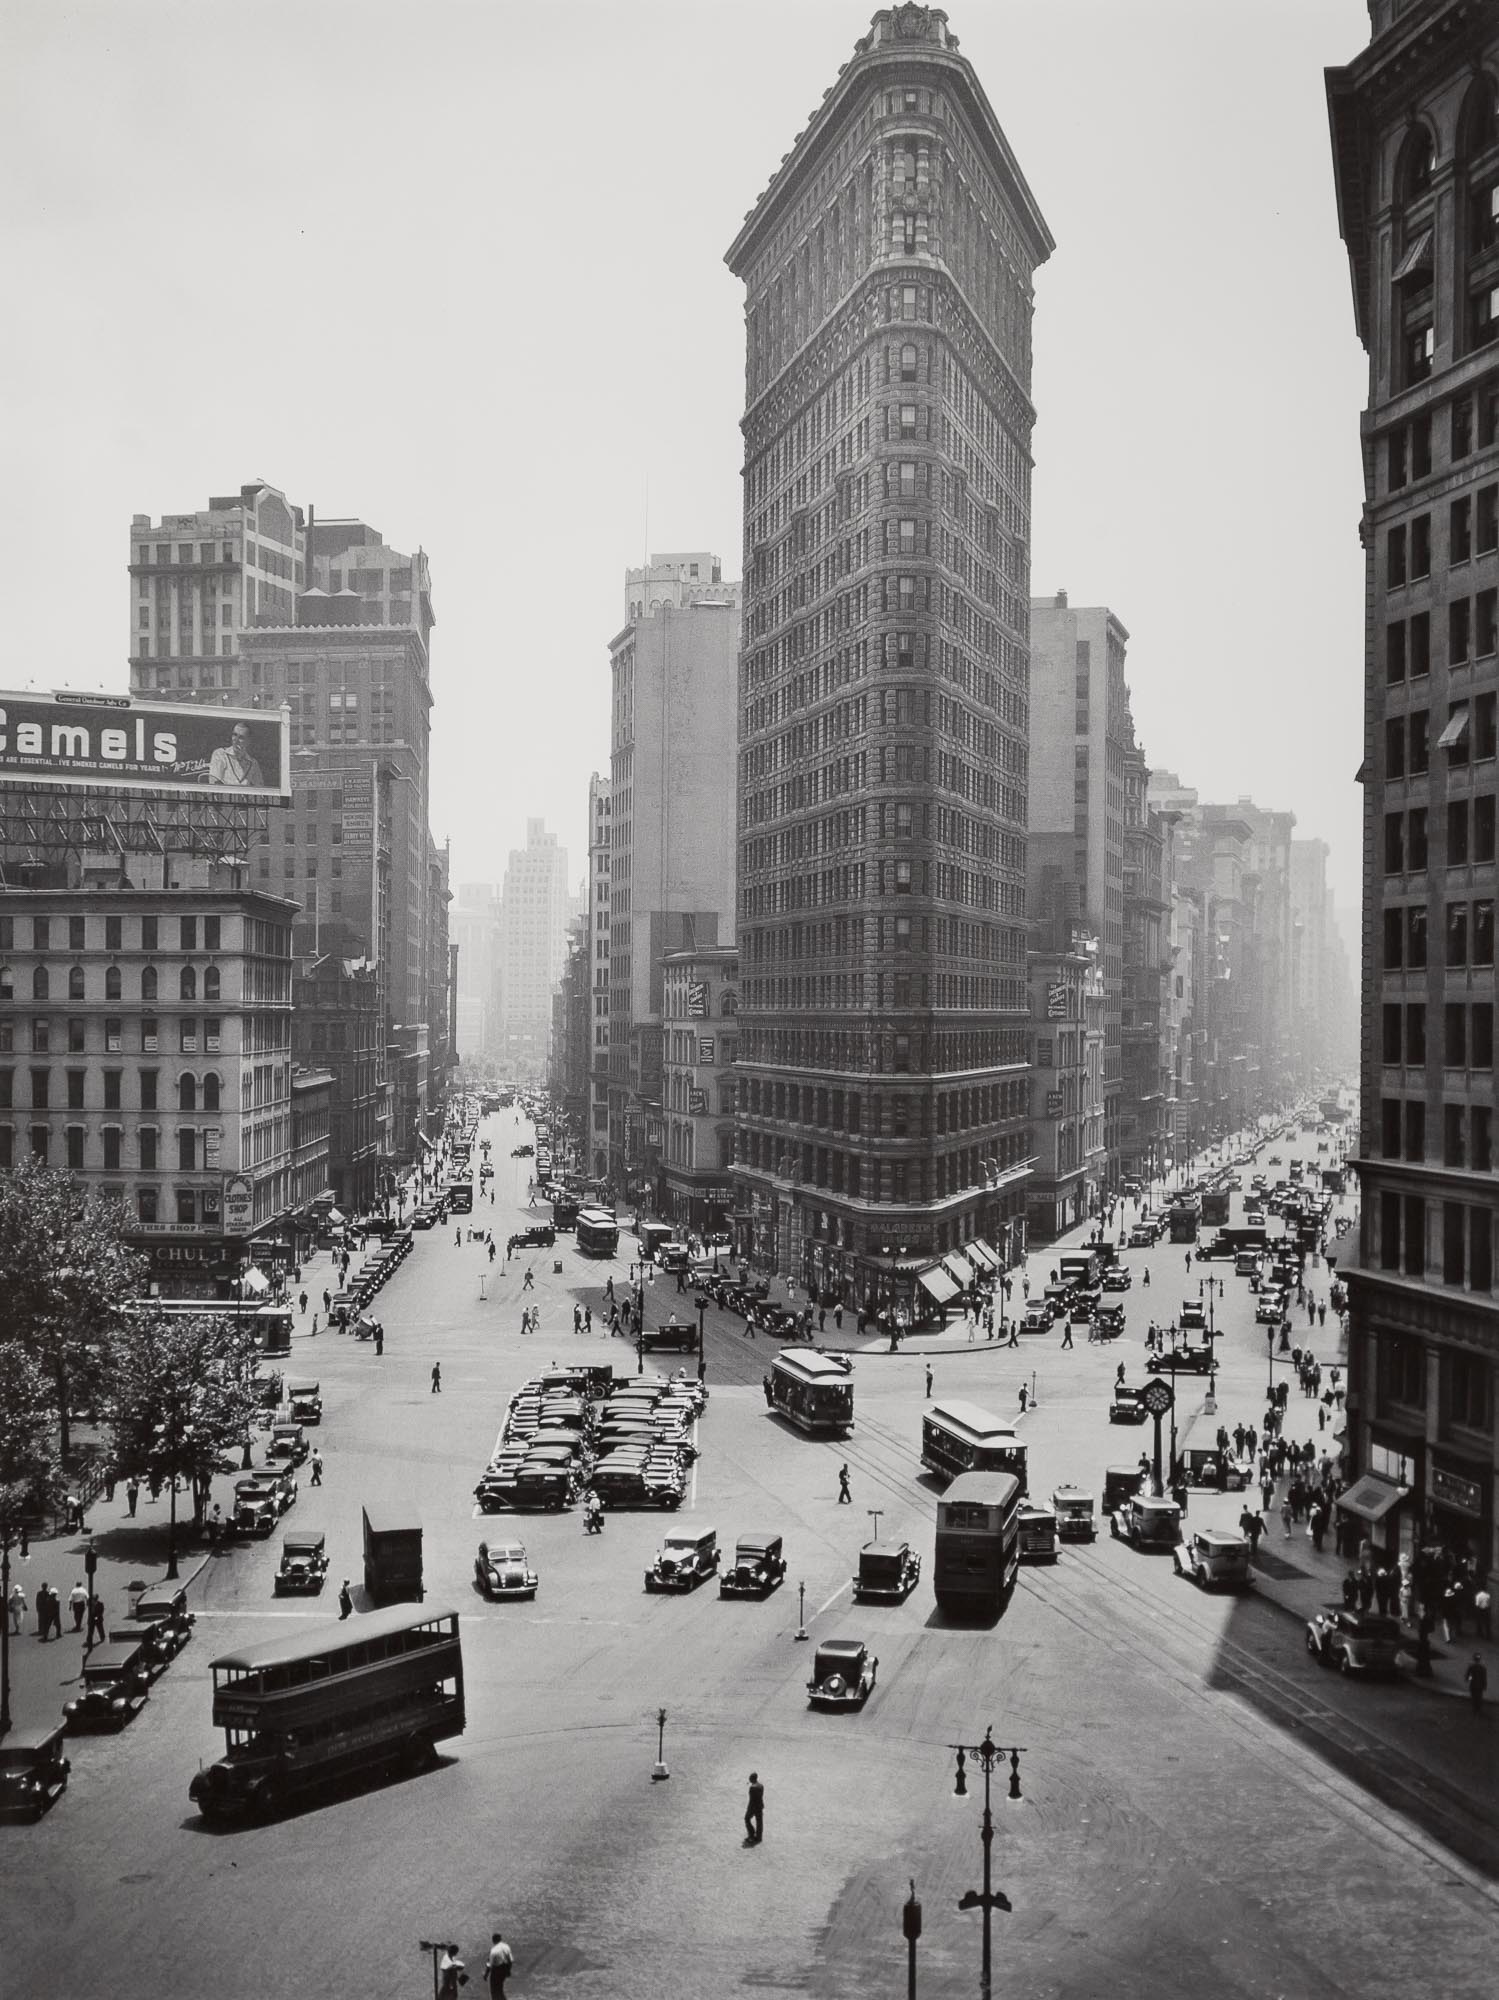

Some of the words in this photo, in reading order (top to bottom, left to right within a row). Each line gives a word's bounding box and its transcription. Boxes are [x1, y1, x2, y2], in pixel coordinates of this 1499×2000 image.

[125, 763, 138, 771] FOR
[224, 1194, 253, 1203] CLOTHES
[228, 1204, 249, 1214] SHOP
[142, 1247, 232, 1262] SCHULE
